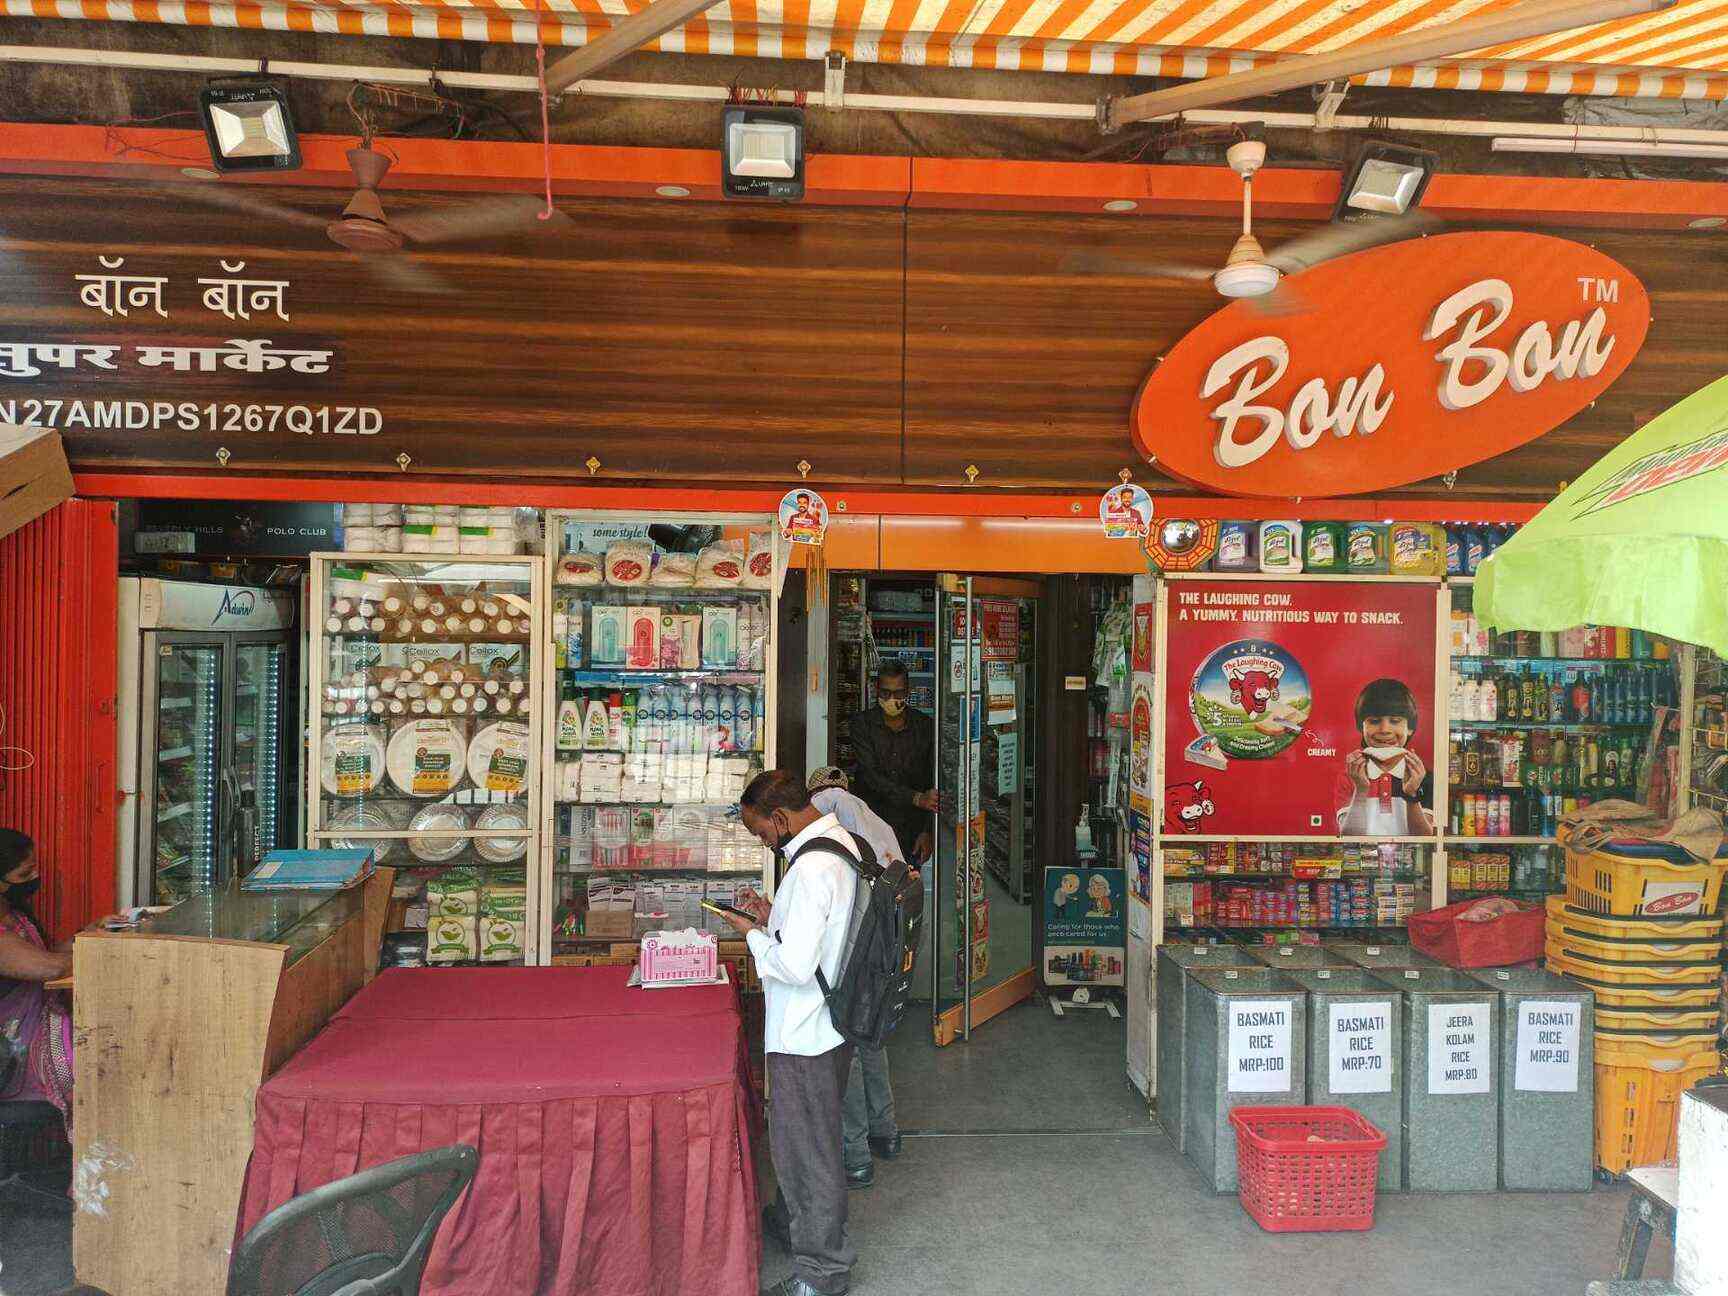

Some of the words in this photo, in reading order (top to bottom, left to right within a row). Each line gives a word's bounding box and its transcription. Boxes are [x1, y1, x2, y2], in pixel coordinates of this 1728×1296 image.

[75, 255, 169, 318] बॉन
[198, 260, 290, 321] बॉन
[1577, 277, 1619, 304] TM
[136, 339, 334, 374] मार्केट
[1200, 336, 1396, 469] Bon
[1424, 278, 1616, 411] Bon
[267, 527, 295, 536] POLO
[299, 528, 327, 536] CLUB
[593, 528, 619, 538] some
[1179, 592, 1200, 605] THE
[1203, 592, 1260, 606] LAUGHING
[1179, 608, 1188, 621] A
[1243, 609, 1310, 624] NUTRITIOUS
[1314, 611, 1339, 624] WAY
[1344, 611, 1357, 624] TO
[1361, 612, 1404, 625] SNACK.
[1307, 748, 1336, 757] CREAMY
[1236, 1011, 1285, 1028] BASMATI
[1336, 1017, 1385, 1033] BASMATI
[1446, 1016, 1474, 1029] JEERA
[1528, 1011, 1574, 1027] BASMATI
[1249, 1035, 1274, 1050] RICE
[1349, 1036, 1374, 1051] RICE
[1446, 1033, 1475, 1046] KOLAM
[1538, 1031, 1563, 1045] RICE
[1238, 1056, 1285, 1072] MRP:100
[1341, 1056, 1382, 1071] MRP:70
[1451, 1050, 1471, 1063] RICE
[1529, 1049, 1570, 1064] MRP:90
[1445, 1068, 1478, 1081] MRP:80
